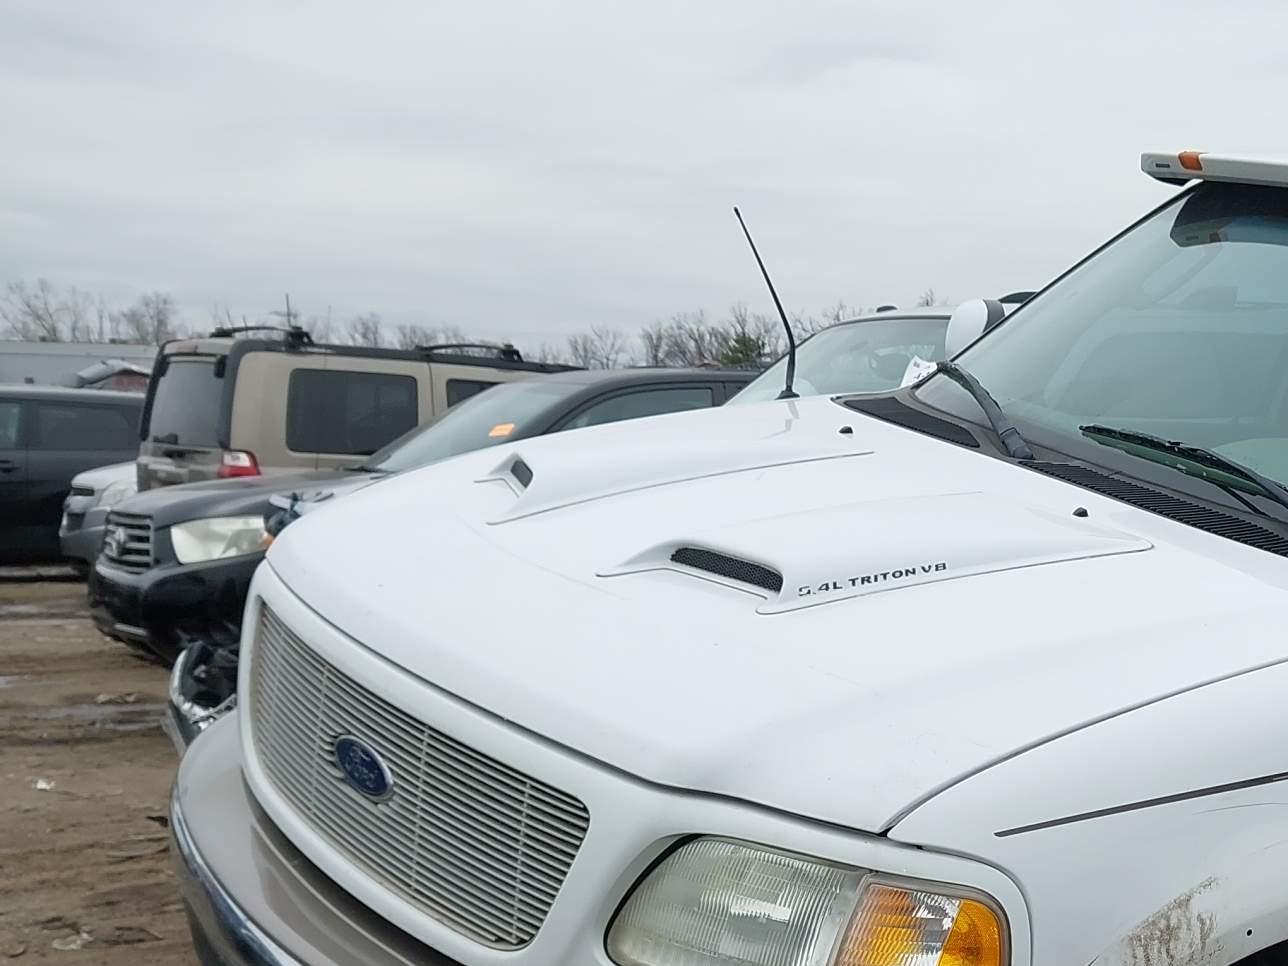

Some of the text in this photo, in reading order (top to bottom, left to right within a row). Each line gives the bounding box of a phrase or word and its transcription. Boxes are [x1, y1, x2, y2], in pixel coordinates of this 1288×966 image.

[798, 562, 947, 597] 5.4L TRITON V8
